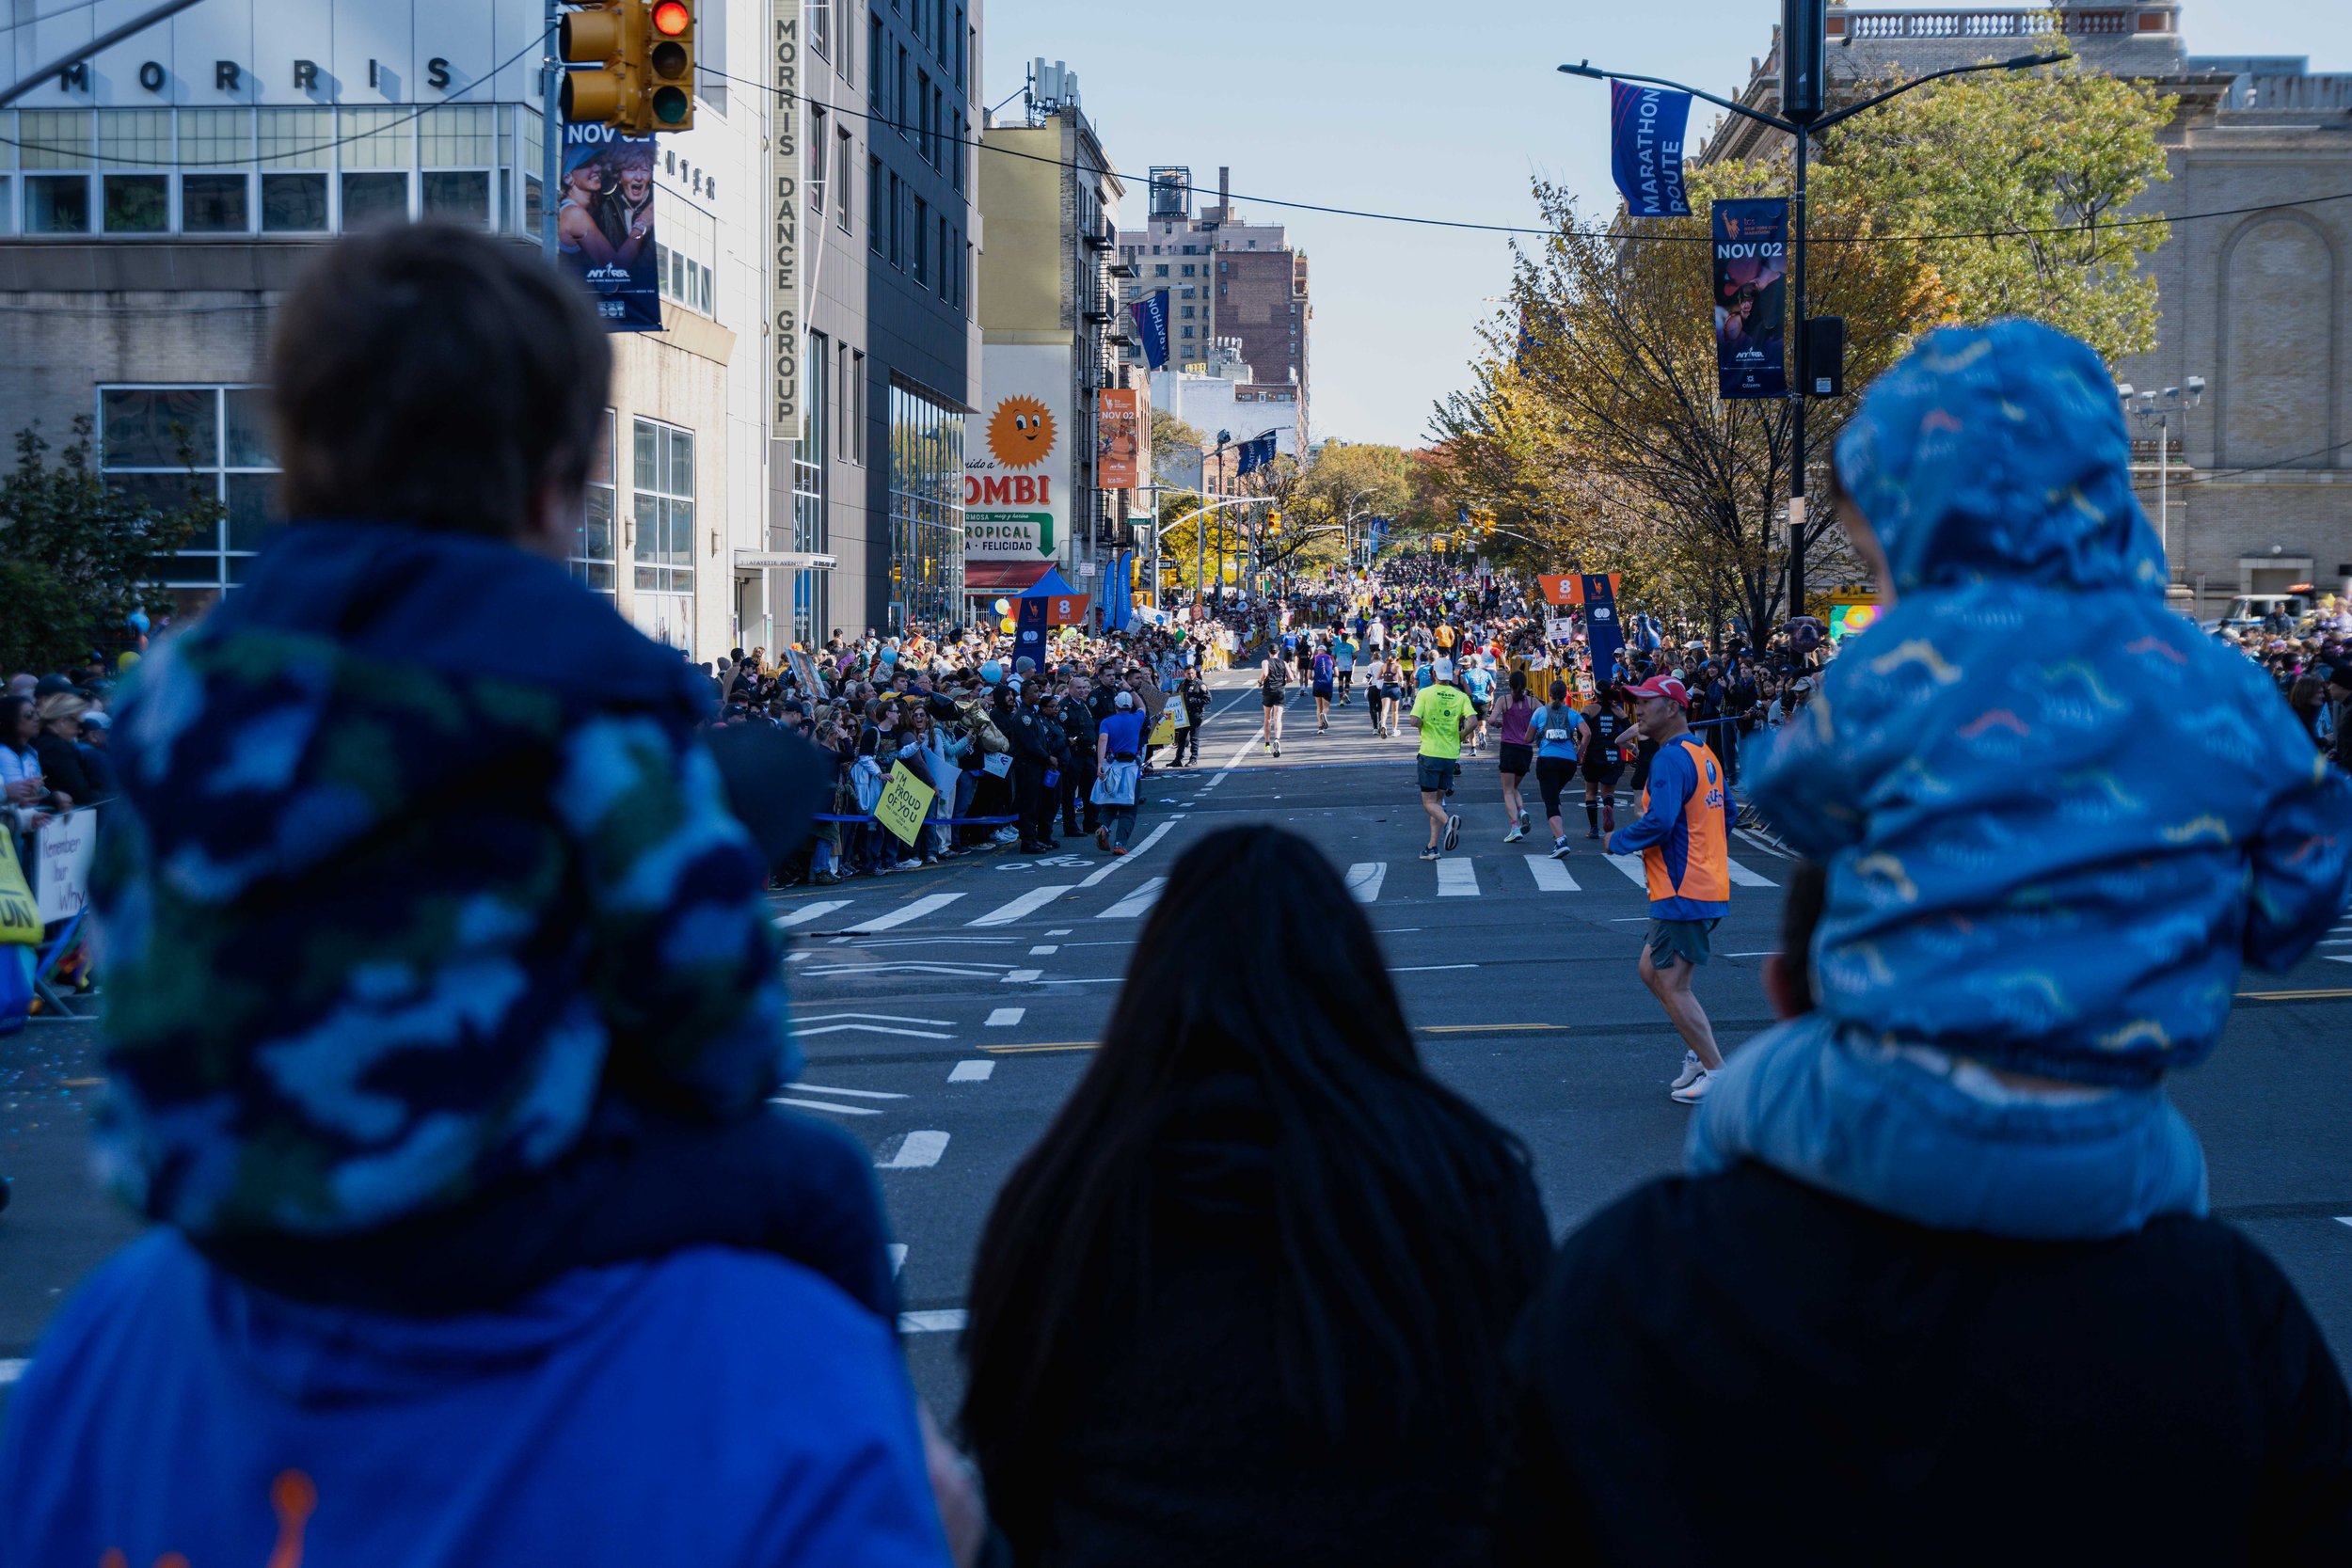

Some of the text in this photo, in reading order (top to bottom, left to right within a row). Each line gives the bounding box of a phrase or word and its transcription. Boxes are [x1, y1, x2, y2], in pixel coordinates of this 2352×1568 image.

[59, 56, 453, 94] MORRIS
[567, 123, 616, 144] NOV
[1637, 87, 1661, 214] MARATHON
[1661, 139, 1688, 214] ROUTE
[776, 19, 797, 423] MORRIS DANCE GROUP
[1718, 242, 1783, 259] NOV 02
[1102, 410, 1135, 420] NOV 02
[965, 474, 1052, 506] OMBI
[965, 526, 1032, 540] ROPICAL
[982, 541, 1033, 551] FELICIDAD
[1559, 579, 1572, 594] 8
[1058, 599, 1071, 614] 8
[896, 770, 908, 787] I'M
[887, 792, 917, 823] OF YOU
[895, 784, 921, 811] PROUD
[42, 825, 82, 861] Remember
[59, 881, 86, 912] Why
[0, 898, 35, 928] UN
